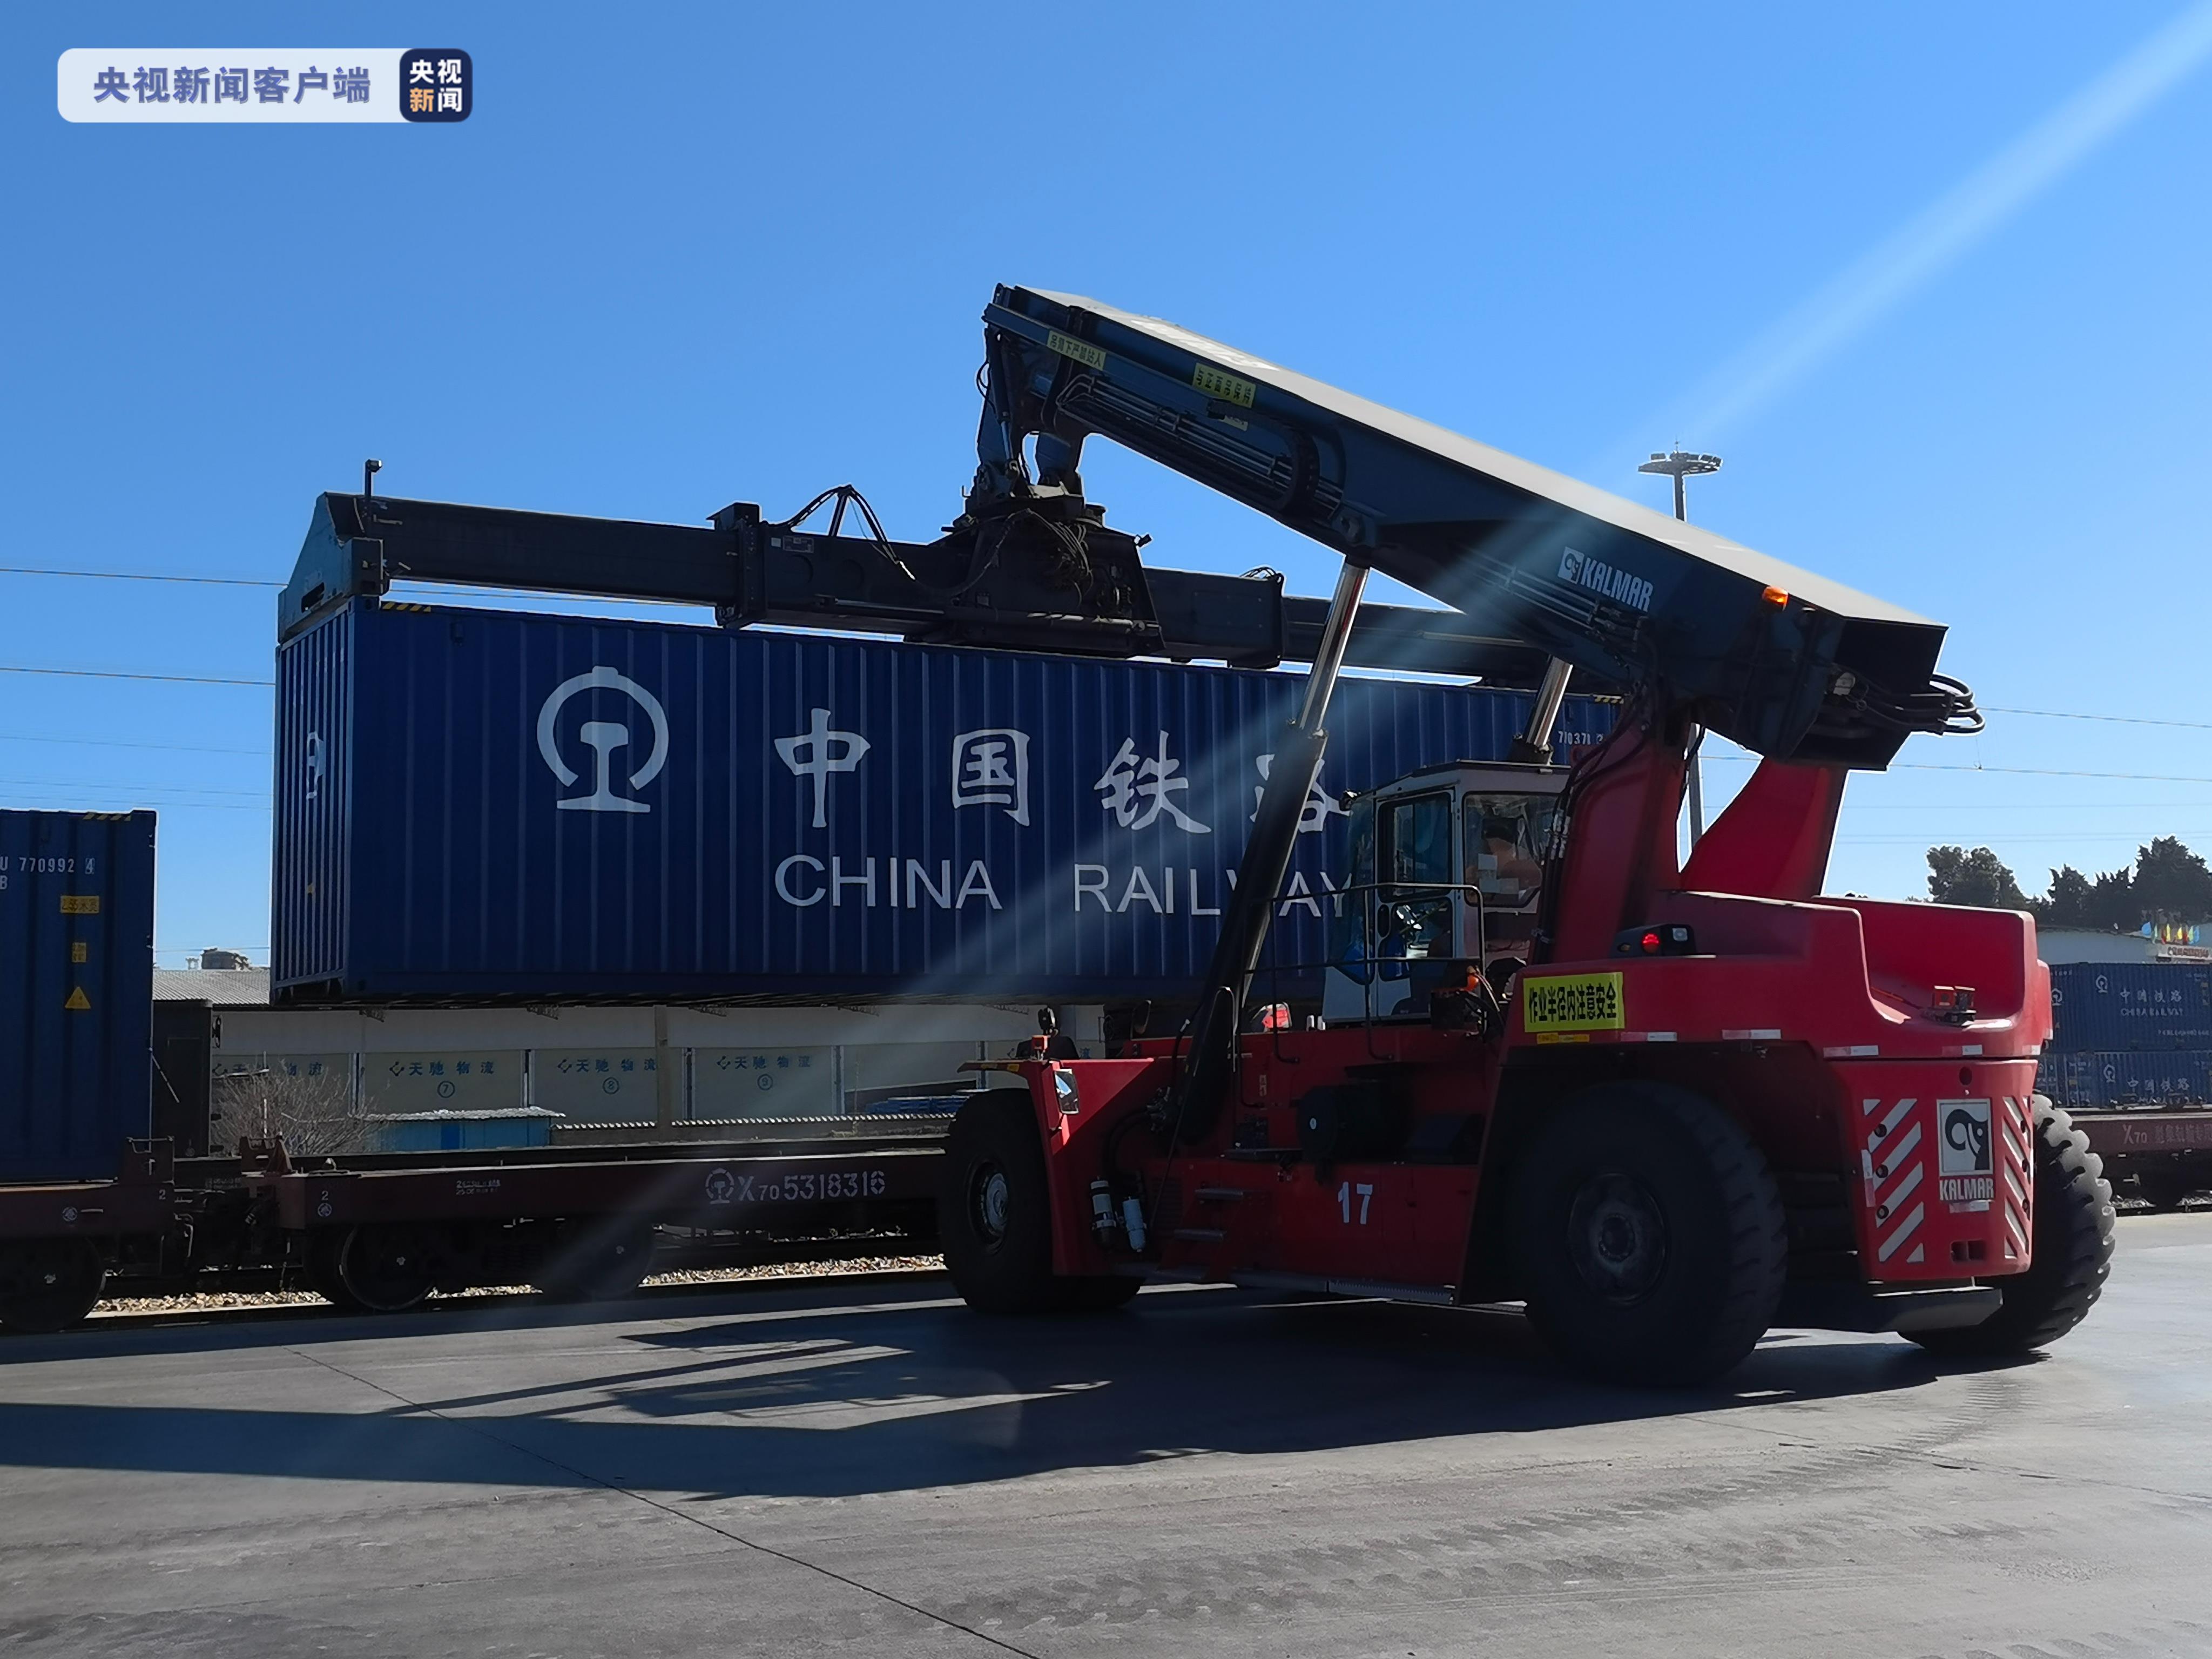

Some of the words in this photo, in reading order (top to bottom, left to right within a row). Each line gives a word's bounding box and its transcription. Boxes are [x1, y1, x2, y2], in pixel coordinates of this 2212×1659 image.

[1581, 557, 1654, 612] KALMAR
[18, 857, 75, 873] 770992
[774, 854, 1002, 909] CHINA
[1074, 864, 1353, 918] RAILAY
[1529, 982, 1617, 1023] 作业半径内注意安全
[409, 1061, 495, 1076] 天驰物流
[576, 1057, 656, 1073] 天驰物流
[735, 1055, 811, 1070] 天驰物流
[321, 1190, 328, 1201] 2
[1939, 1177, 1994, 1201] KALMAR
[1338, 1182, 1373, 1224] 17
